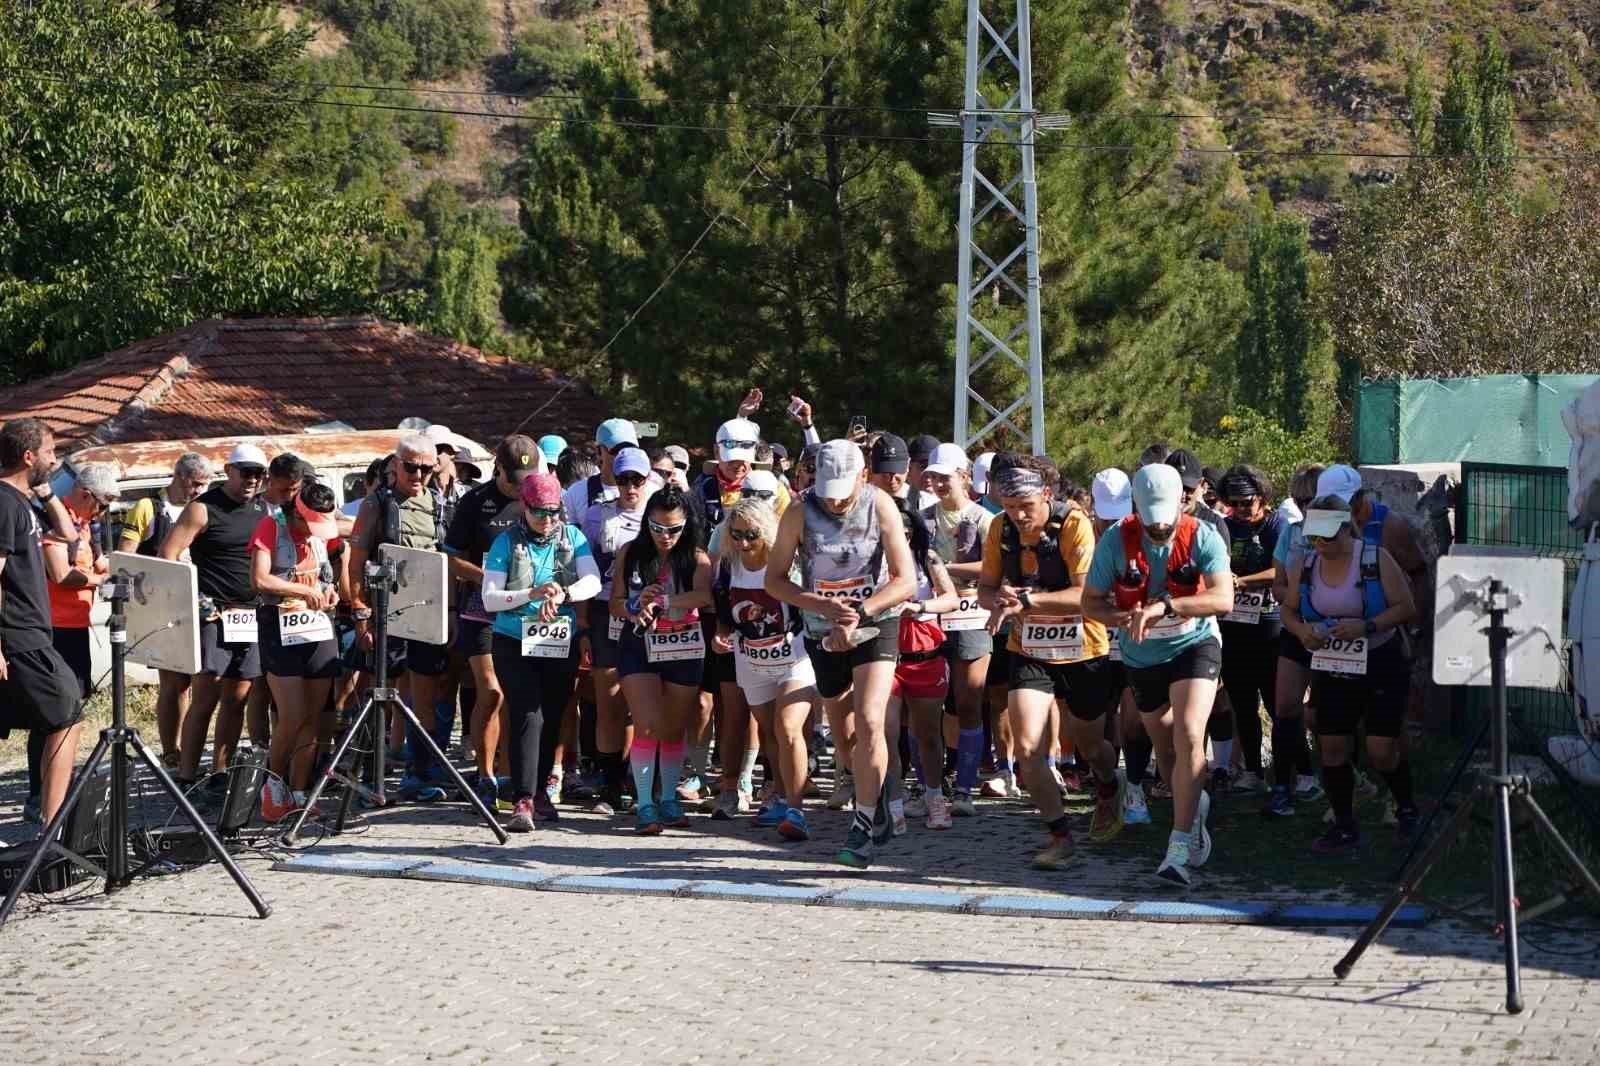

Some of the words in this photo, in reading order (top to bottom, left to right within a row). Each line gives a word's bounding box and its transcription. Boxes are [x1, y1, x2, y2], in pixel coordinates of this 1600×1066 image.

[528, 624, 568, 639] 6048
[651, 632, 699, 645] 18054
[1027, 626, 1077, 640] 18014
[745, 643, 792, 660] 18068
